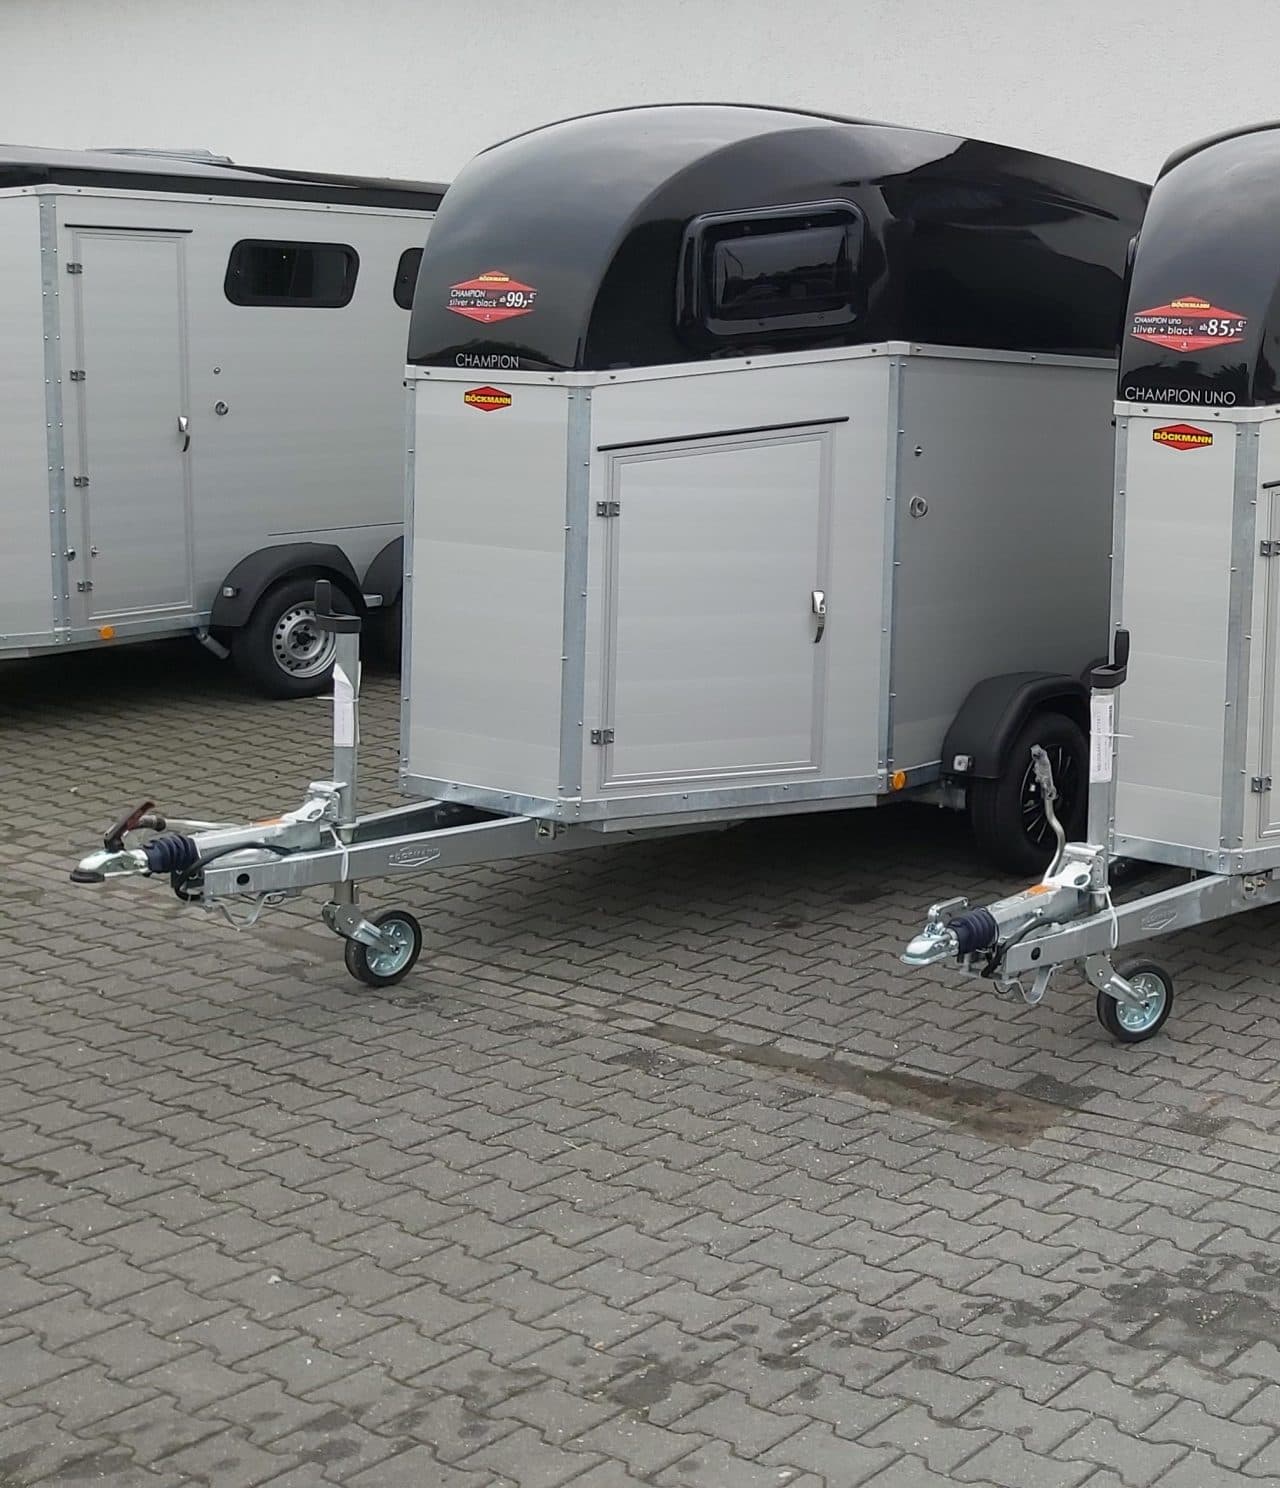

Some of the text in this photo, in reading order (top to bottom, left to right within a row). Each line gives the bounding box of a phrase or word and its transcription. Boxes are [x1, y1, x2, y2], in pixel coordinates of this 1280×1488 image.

[451, 290, 485, 298] CHAMPION
[476, 299, 496, 307] black
[1133, 326, 1157, 334] silver
[1168, 327, 1194, 336] black
[456, 353, 519, 368] CHAMPION
[465, 395, 511, 404] BÖCKMANN
[1125, 386, 1236, 405] CHAMPION UNO
[1154, 432, 1212, 444] BÖCKMANN
